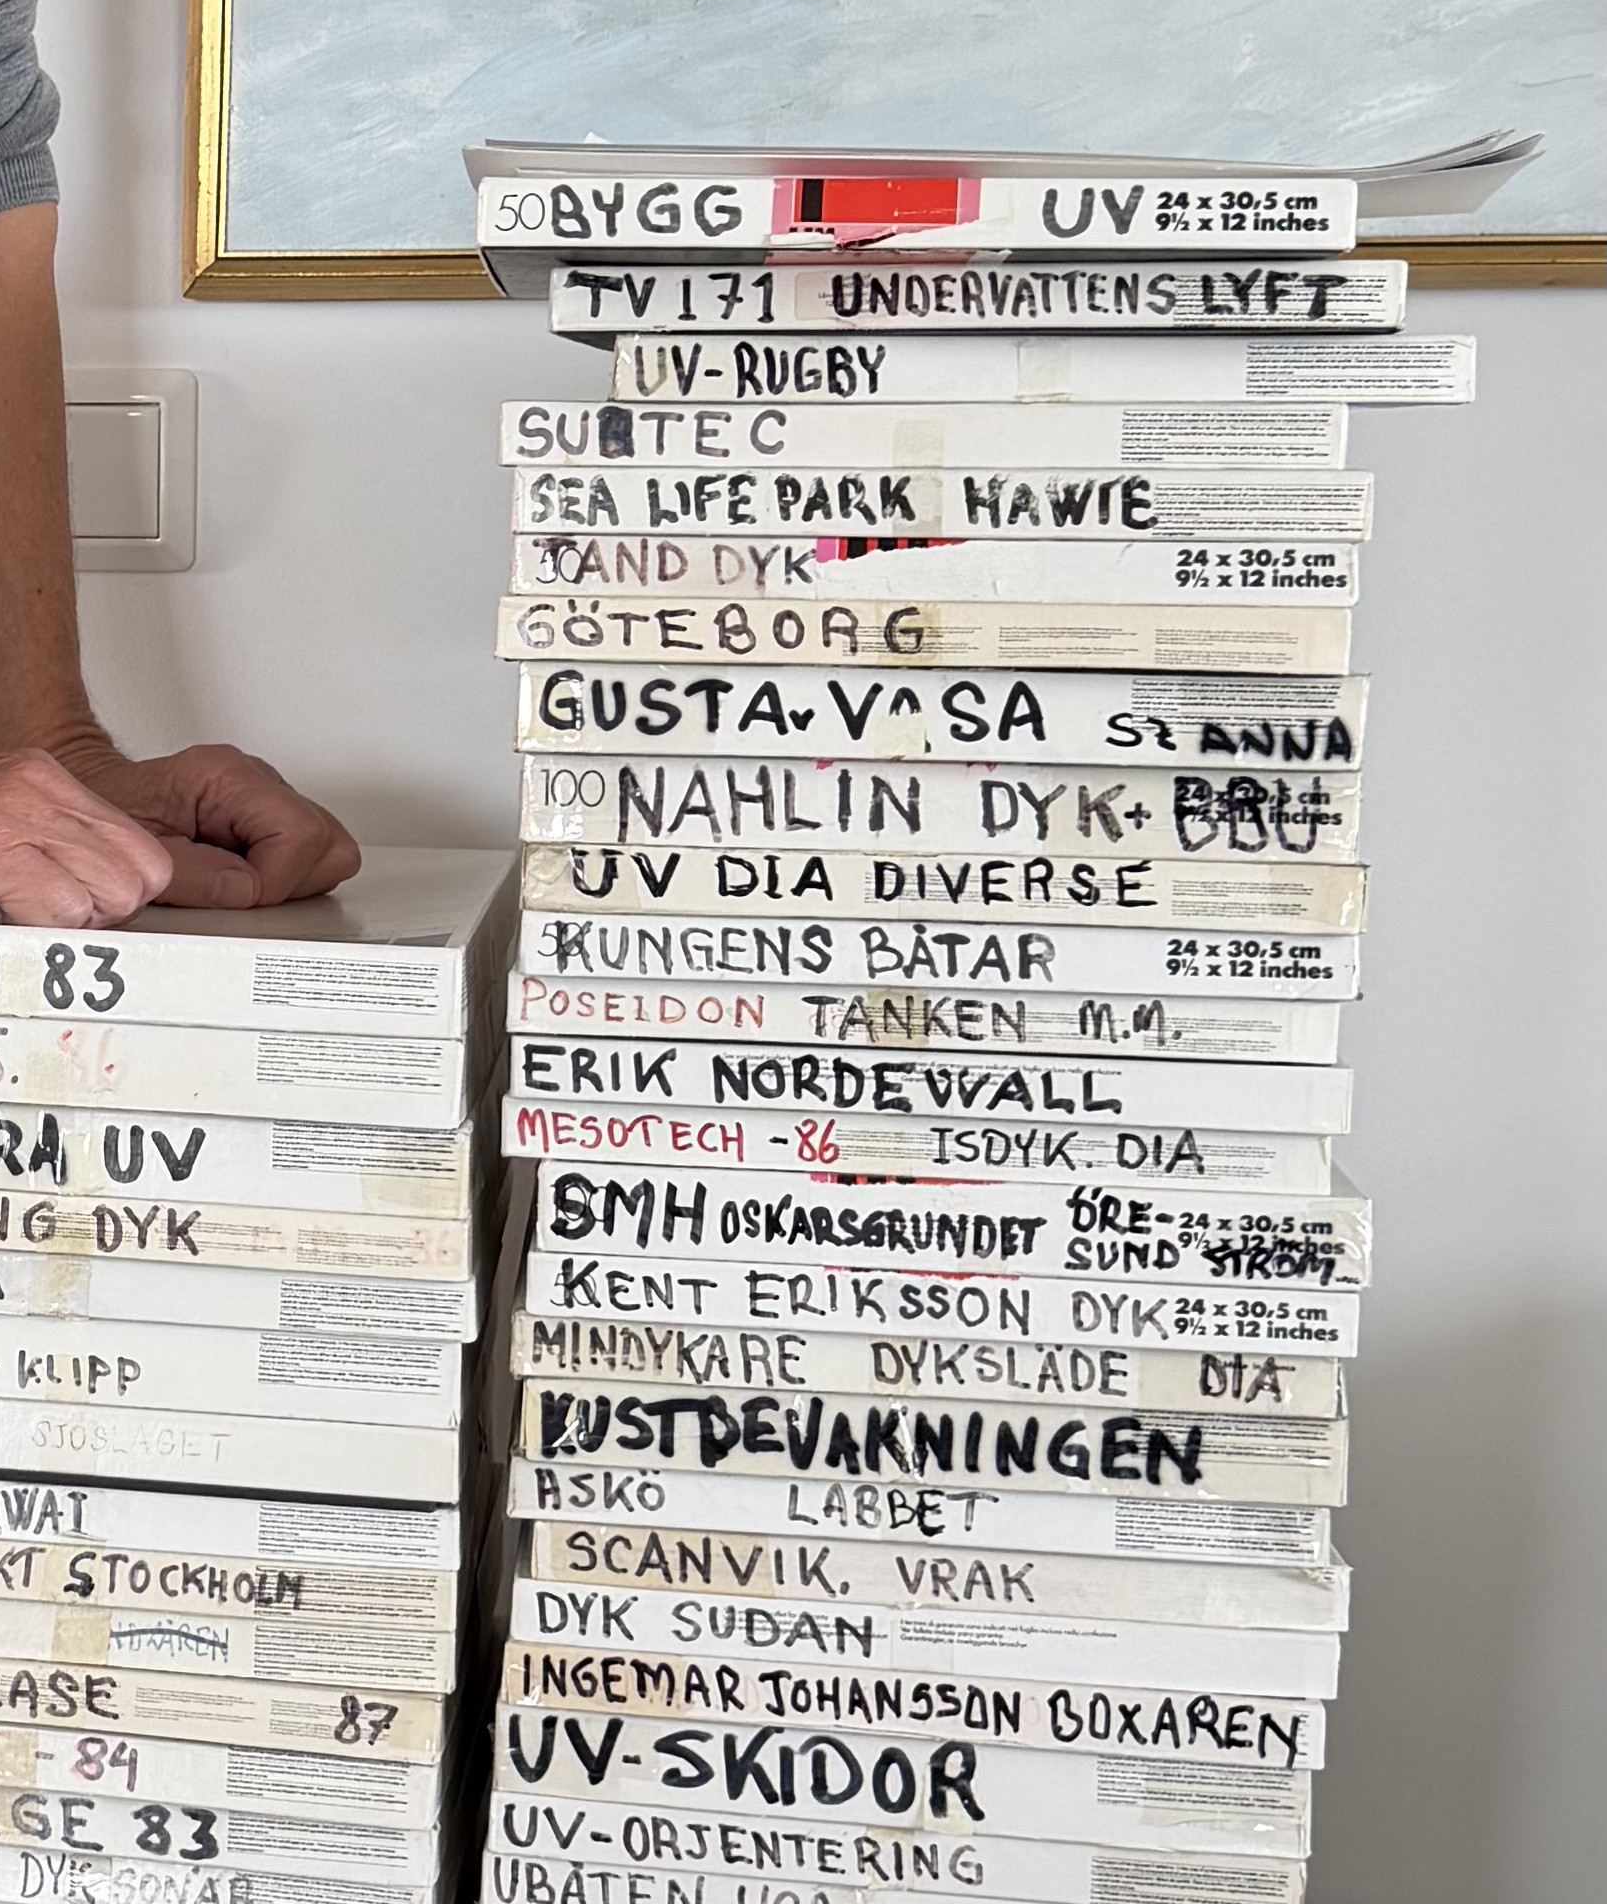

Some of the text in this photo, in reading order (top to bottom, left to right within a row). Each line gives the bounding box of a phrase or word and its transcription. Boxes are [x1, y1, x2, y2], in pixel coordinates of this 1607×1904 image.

[495, 192, 545, 232] 50
[549, 182, 1144, 239] BYGG UV
[1156, 191, 1317, 211] 24 30,5 cm
[1220, 213, 1330, 233] 12 inches
[564, 270, 656, 319] TV
[829, 268, 1177, 319] UNDERVATTENS
[1200, 268, 1348, 321] LYFT
[634, 342, 886, 398] UV-RUGBY
[529, 472, 917, 529] SEA LIFE PARK
[713, 543, 816, 586] DYK
[516, 598, 925, 656] GÖTEBORG
[1199, 716, 1353, 762] ANNA
[540, 768, 606, 808] 100
[616, 763, 922, 844] NAHLIN
[570, 846, 682, 899] UV
[715, 853, 834, 901] DIA
[871, 857, 1159, 908] DIVERSE
[42, 942, 126, 1013] 83
[554, 919, 1057, 983] KUNGENS BÅTAR
[520, 977, 765, 1029] POSEIDON
[801, 993, 1026, 1044] TANKEN
[521, 1043, 679, 1097] ERIK
[103, 1124, 207, 1185] UV
[516, 1107, 746, 1164] MESOTECH
[1115, 1129, 1206, 1176] DIA
[91, 1203, 202, 1257] DYK
[719, 1192, 1048, 1260] OSKARSGRUNDET
[1063, 1237, 1181, 1274] SUND
[556, 1257, 1169, 1341] KENT ERIKSSON DYK
[16, 1350, 142, 1396] KLIPP
[531, 1320, 1285, 1404] MINDYKARE DYKSLÄDE DIA
[539, 1389, 1203, 1486] KUSTBEVAKNINGEN
[787, 1481, 1000, 1537] LABBET
[62, 1550, 306, 1611] STOCKHOLM
[894, 1555, 1035, 1604] VRAK
[535, 1591, 640, 1642] DYK
[670, 1600, 874, 1658] SUDAN
[333, 1694, 399, 1746] 87
[520, 1652, 746, 1713] INGEMAR
[757, 1669, 1023, 1737] JOHANSSON
[1047, 1687, 1301, 1771] BOXAREN
[73, 1736, 138, 1794] 84
[507, 1712, 986, 1822] UV-SKIDOR
[131, 1803, 220, 1860] 83
